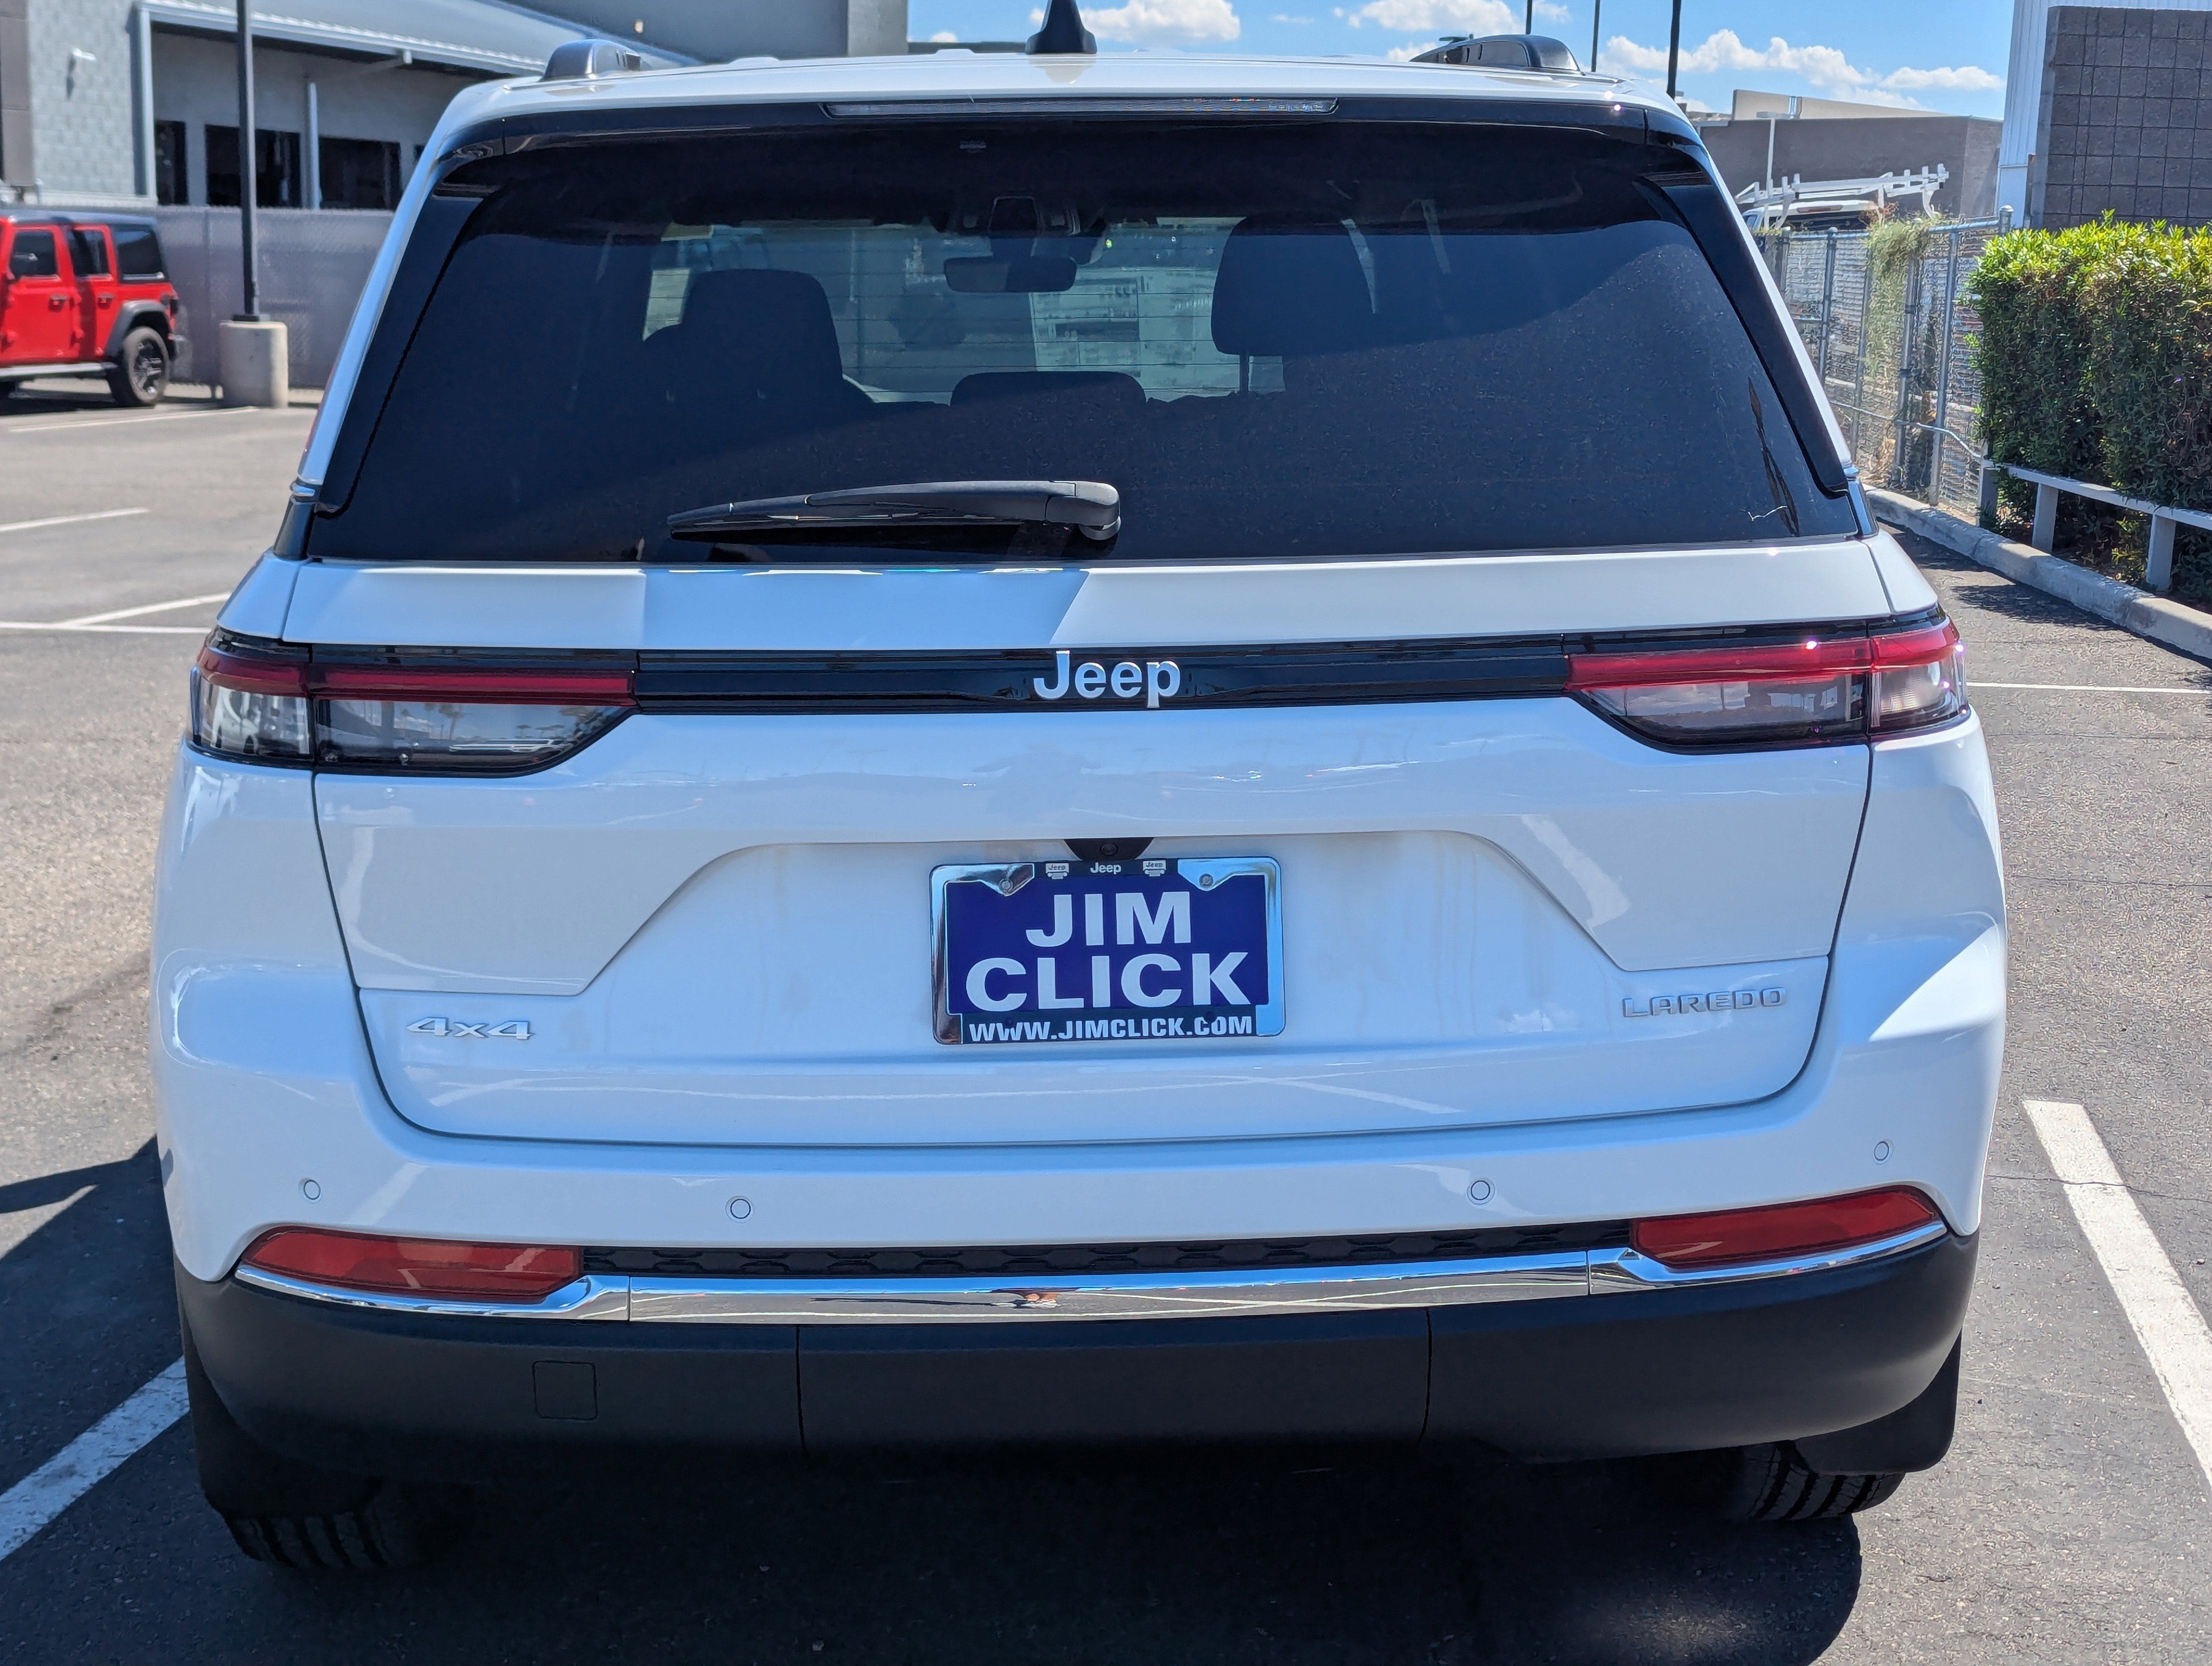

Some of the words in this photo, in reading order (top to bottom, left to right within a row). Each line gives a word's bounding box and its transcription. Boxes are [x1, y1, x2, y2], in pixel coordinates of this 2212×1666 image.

[1033, 650, 1180, 708] Jeep
[1090, 862, 1122, 875] Jeep
[1026, 891, 1191, 947] JIM
[966, 952, 1252, 1011] CLICK
[1622, 986, 1787, 1018] LAREDO
[406, 1016, 536, 1040] 4x4
[968, 1016, 1252, 1042] WWW.JIMCLICK.COM
